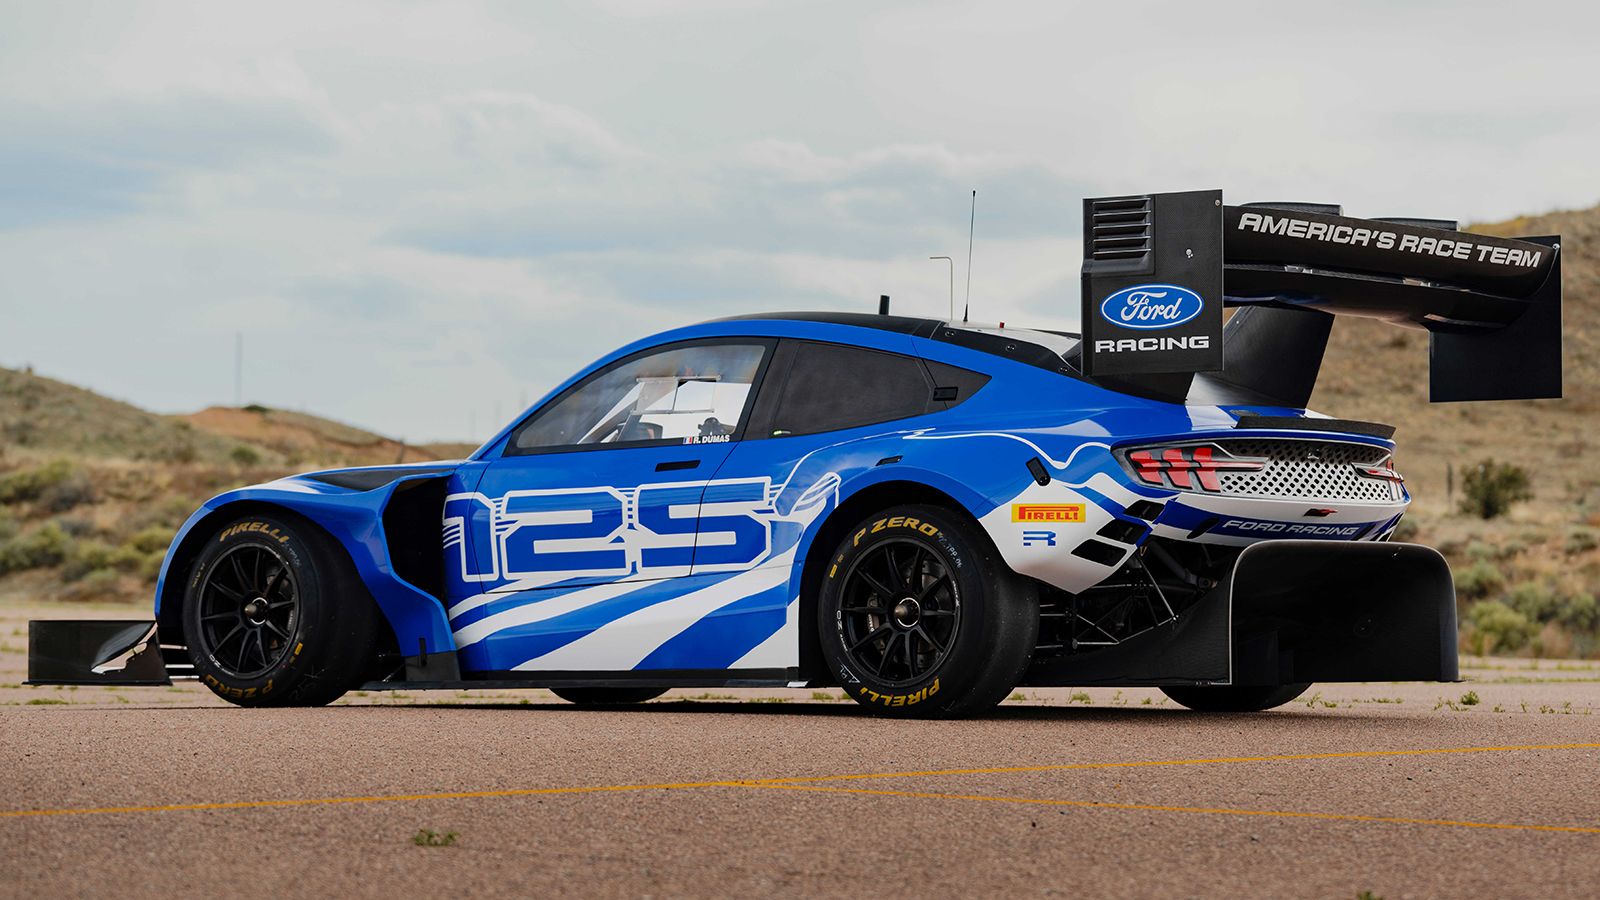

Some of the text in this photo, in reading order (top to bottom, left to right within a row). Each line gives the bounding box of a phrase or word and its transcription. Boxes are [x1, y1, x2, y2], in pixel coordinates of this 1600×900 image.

[1238, 213, 1542, 268] AMERICA'S RACE TEAM
[1120, 291, 1183, 321] Ford
[1095, 336, 1209, 353] RACING
[693, 434, 730, 444] R. DUMAS
[1018, 506, 1080, 520] PIRELLI
[219, 521, 290, 543] PIRELLI
[442, 476, 772, 583] 125
[853, 516, 939, 547] P ZERO
[1222, 519, 1359, 536] FORD RACING
[205, 673, 257, 698] ZERO
[860, 678, 941, 707] PIRELLI
